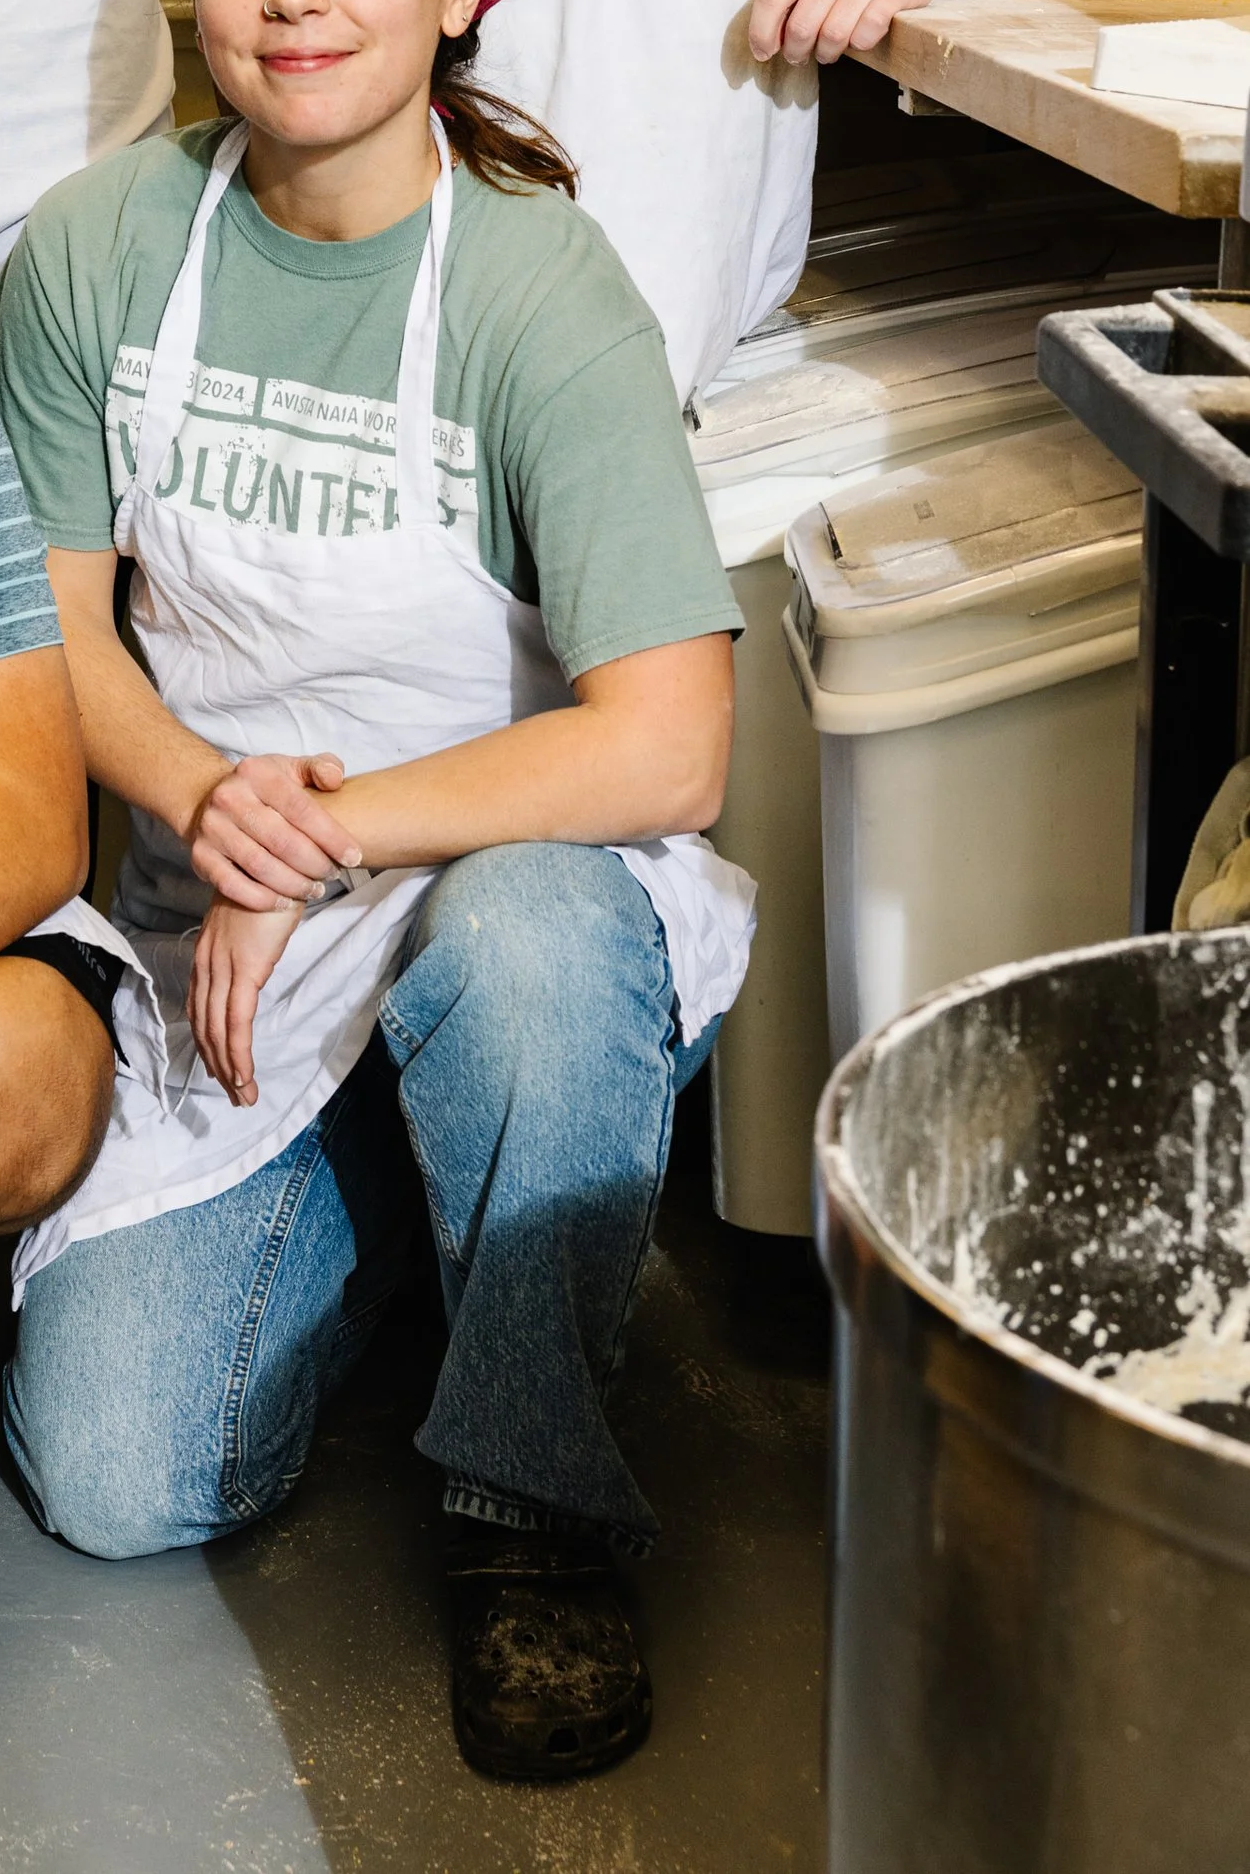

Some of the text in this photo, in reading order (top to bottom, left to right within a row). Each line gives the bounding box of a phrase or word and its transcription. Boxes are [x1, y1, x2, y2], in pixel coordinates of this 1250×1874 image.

[200, 377, 245, 402] 2024
[272, 390, 465, 457] AVISTA NAIA WOR ERIES
